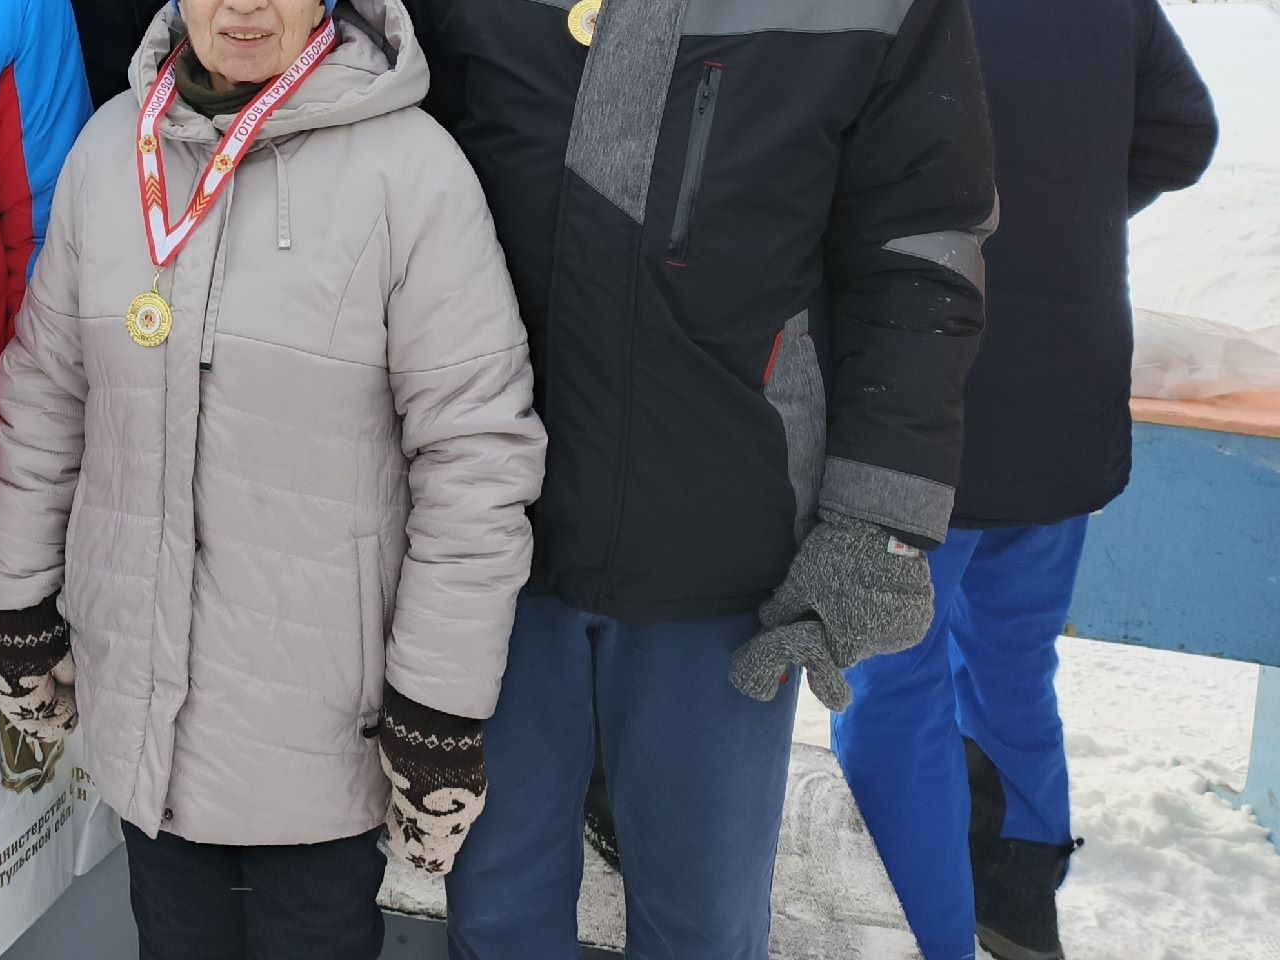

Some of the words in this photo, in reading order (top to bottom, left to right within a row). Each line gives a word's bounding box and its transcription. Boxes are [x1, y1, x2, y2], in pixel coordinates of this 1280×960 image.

[144, 76, 174, 119] ОБОРОНЕ
[265, 72, 296, 100] ТРУДУ
[259, 99, 272, 108] К
[234, 106, 264, 142] ГОТОВ
